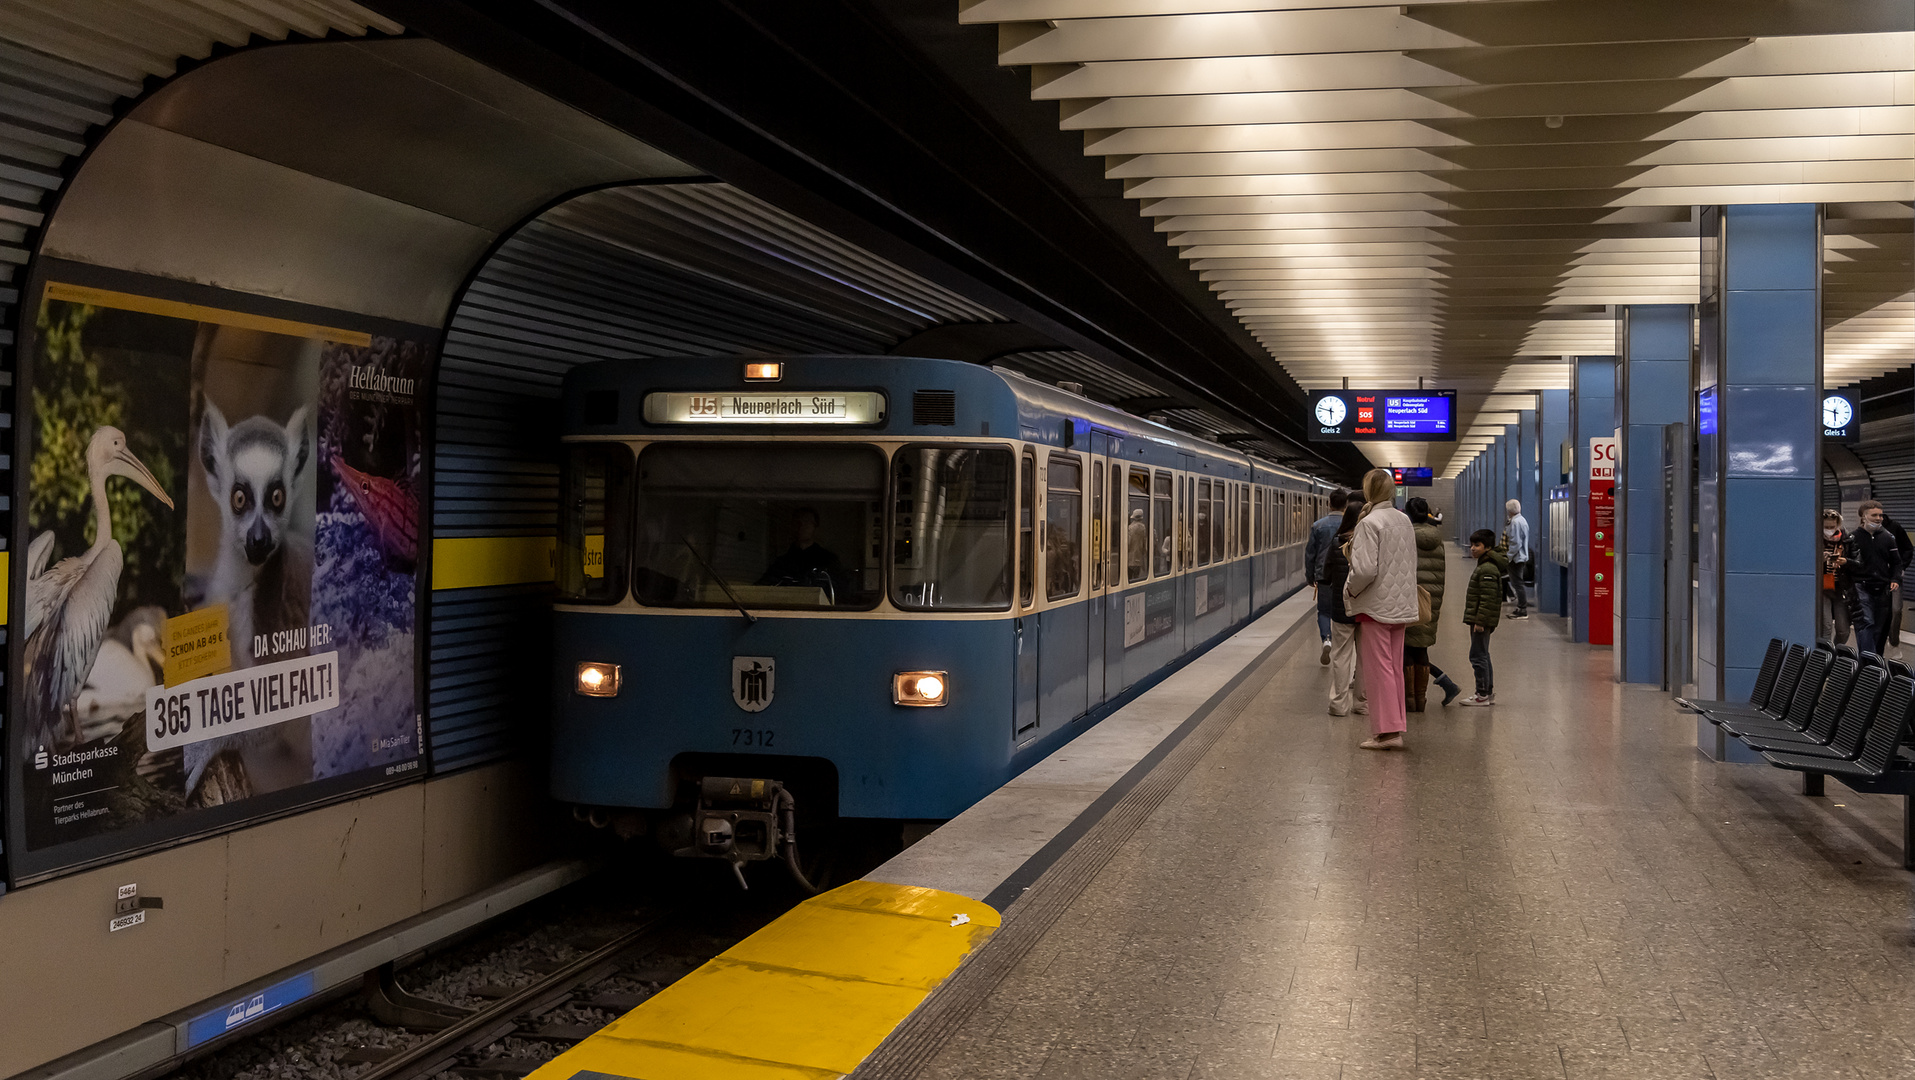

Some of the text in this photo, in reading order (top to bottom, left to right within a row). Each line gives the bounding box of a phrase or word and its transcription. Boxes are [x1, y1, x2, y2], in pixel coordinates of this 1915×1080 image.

[350, 365, 414, 395] Hellabrunn
[690, 396, 835, 415] U5 Neuperlach Süd
[183, 624, 204, 638] GANZES
[170, 632, 223, 658] SCHON AB 49 €
[254, 623, 332, 658] DA SCHAU HER:
[154, 662, 332, 739] 365 TAGE VIELFALT!
[732, 729, 775, 747] 7312
[52, 746, 118, 767] Stadtsparkasse
[52, 768, 93, 785] München
[54, 800, 84, 814] Partner des
[54, 813, 80, 825] Tierparks
[120, 886, 135, 896] 5464
[134, 914, 142, 923] 24
